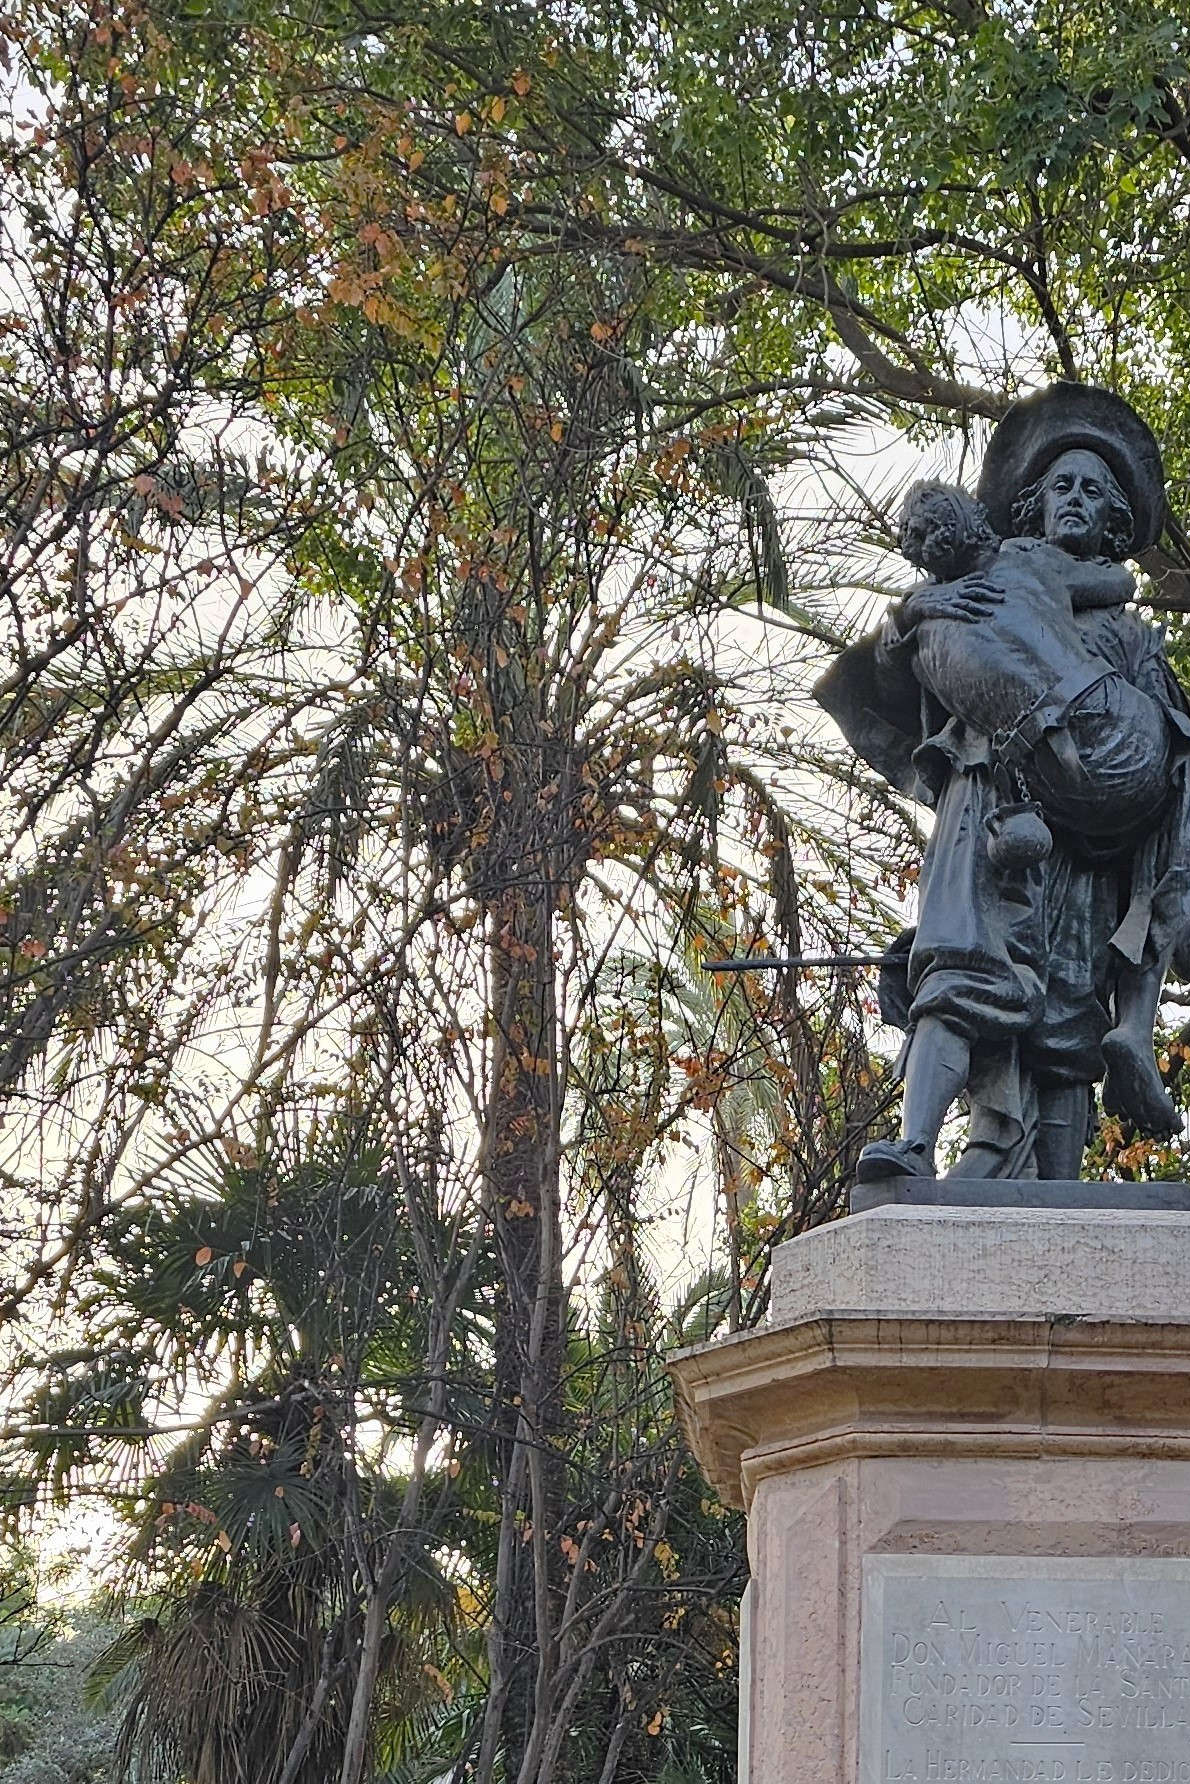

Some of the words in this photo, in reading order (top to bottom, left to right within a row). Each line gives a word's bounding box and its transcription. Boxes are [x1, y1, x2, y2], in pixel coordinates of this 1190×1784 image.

[926, 1600, 977, 1633] AL
[999, 1600, 1164, 1635] VENERABLE
[891, 1632, 946, 1667] DON
[959, 1633, 1066, 1668] MIGUEL
[889, 1664, 1022, 1697] FUNDADOR
[1031, 1674, 1062, 1698] DE
[1074, 1674, 1106, 1699] LA
[903, 1696, 1019, 1728] CARIDAD
[1030, 1704, 1064, 1729] DE
[1078, 1697, 1190, 1730] SEVILLA
[885, 1749, 918, 1782] LA
[925, 1748, 1066, 1782] HERMANDAD
[1075, 1759, 1114, 1783] LE
